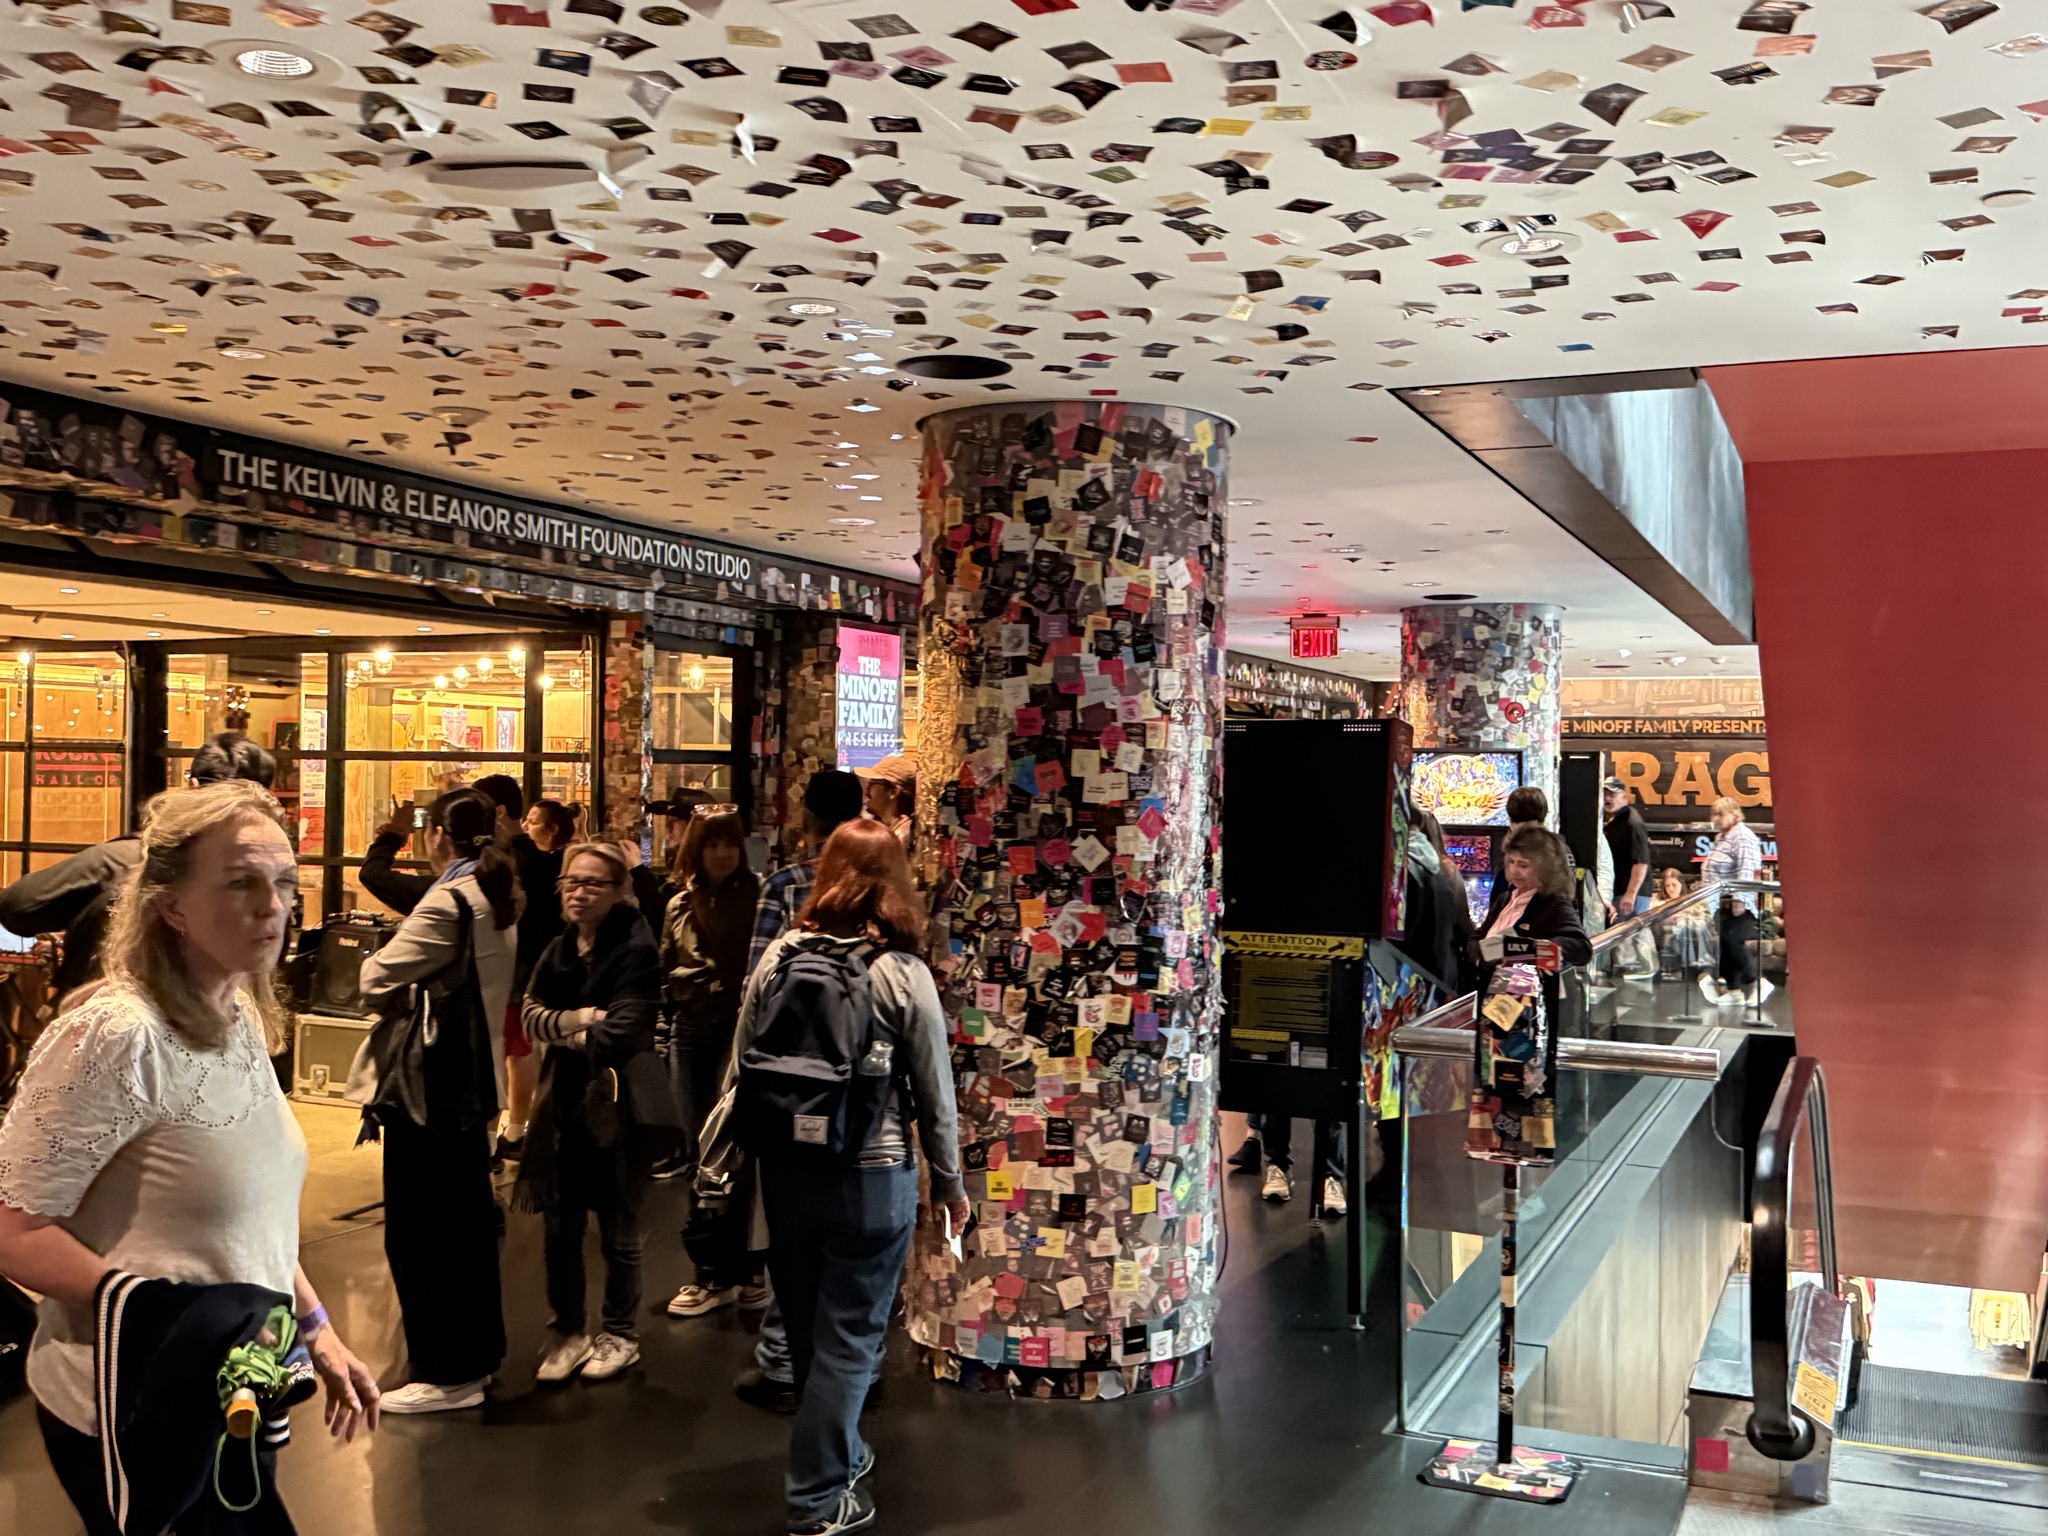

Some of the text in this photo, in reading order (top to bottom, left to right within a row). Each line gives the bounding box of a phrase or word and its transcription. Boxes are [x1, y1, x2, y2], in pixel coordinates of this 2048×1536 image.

[217, 449, 751, 581] THE KELVIN & ELEANOR SMITH FOUNDATION STUDIO
[1300, 629, 1333, 657] EXIT
[858, 656, 881, 676] THE
[839, 674, 897, 703] MINOFF
[838, 700, 897, 729] FAMILY
[1573, 719, 1632, 734] MINOFF
[1635, 719, 1690, 734] FAMILY
[838, 731, 896, 748] PRESENTS
[35, 774, 83, 785] HALL
[1240, 933, 1327, 946] ATTENTION
